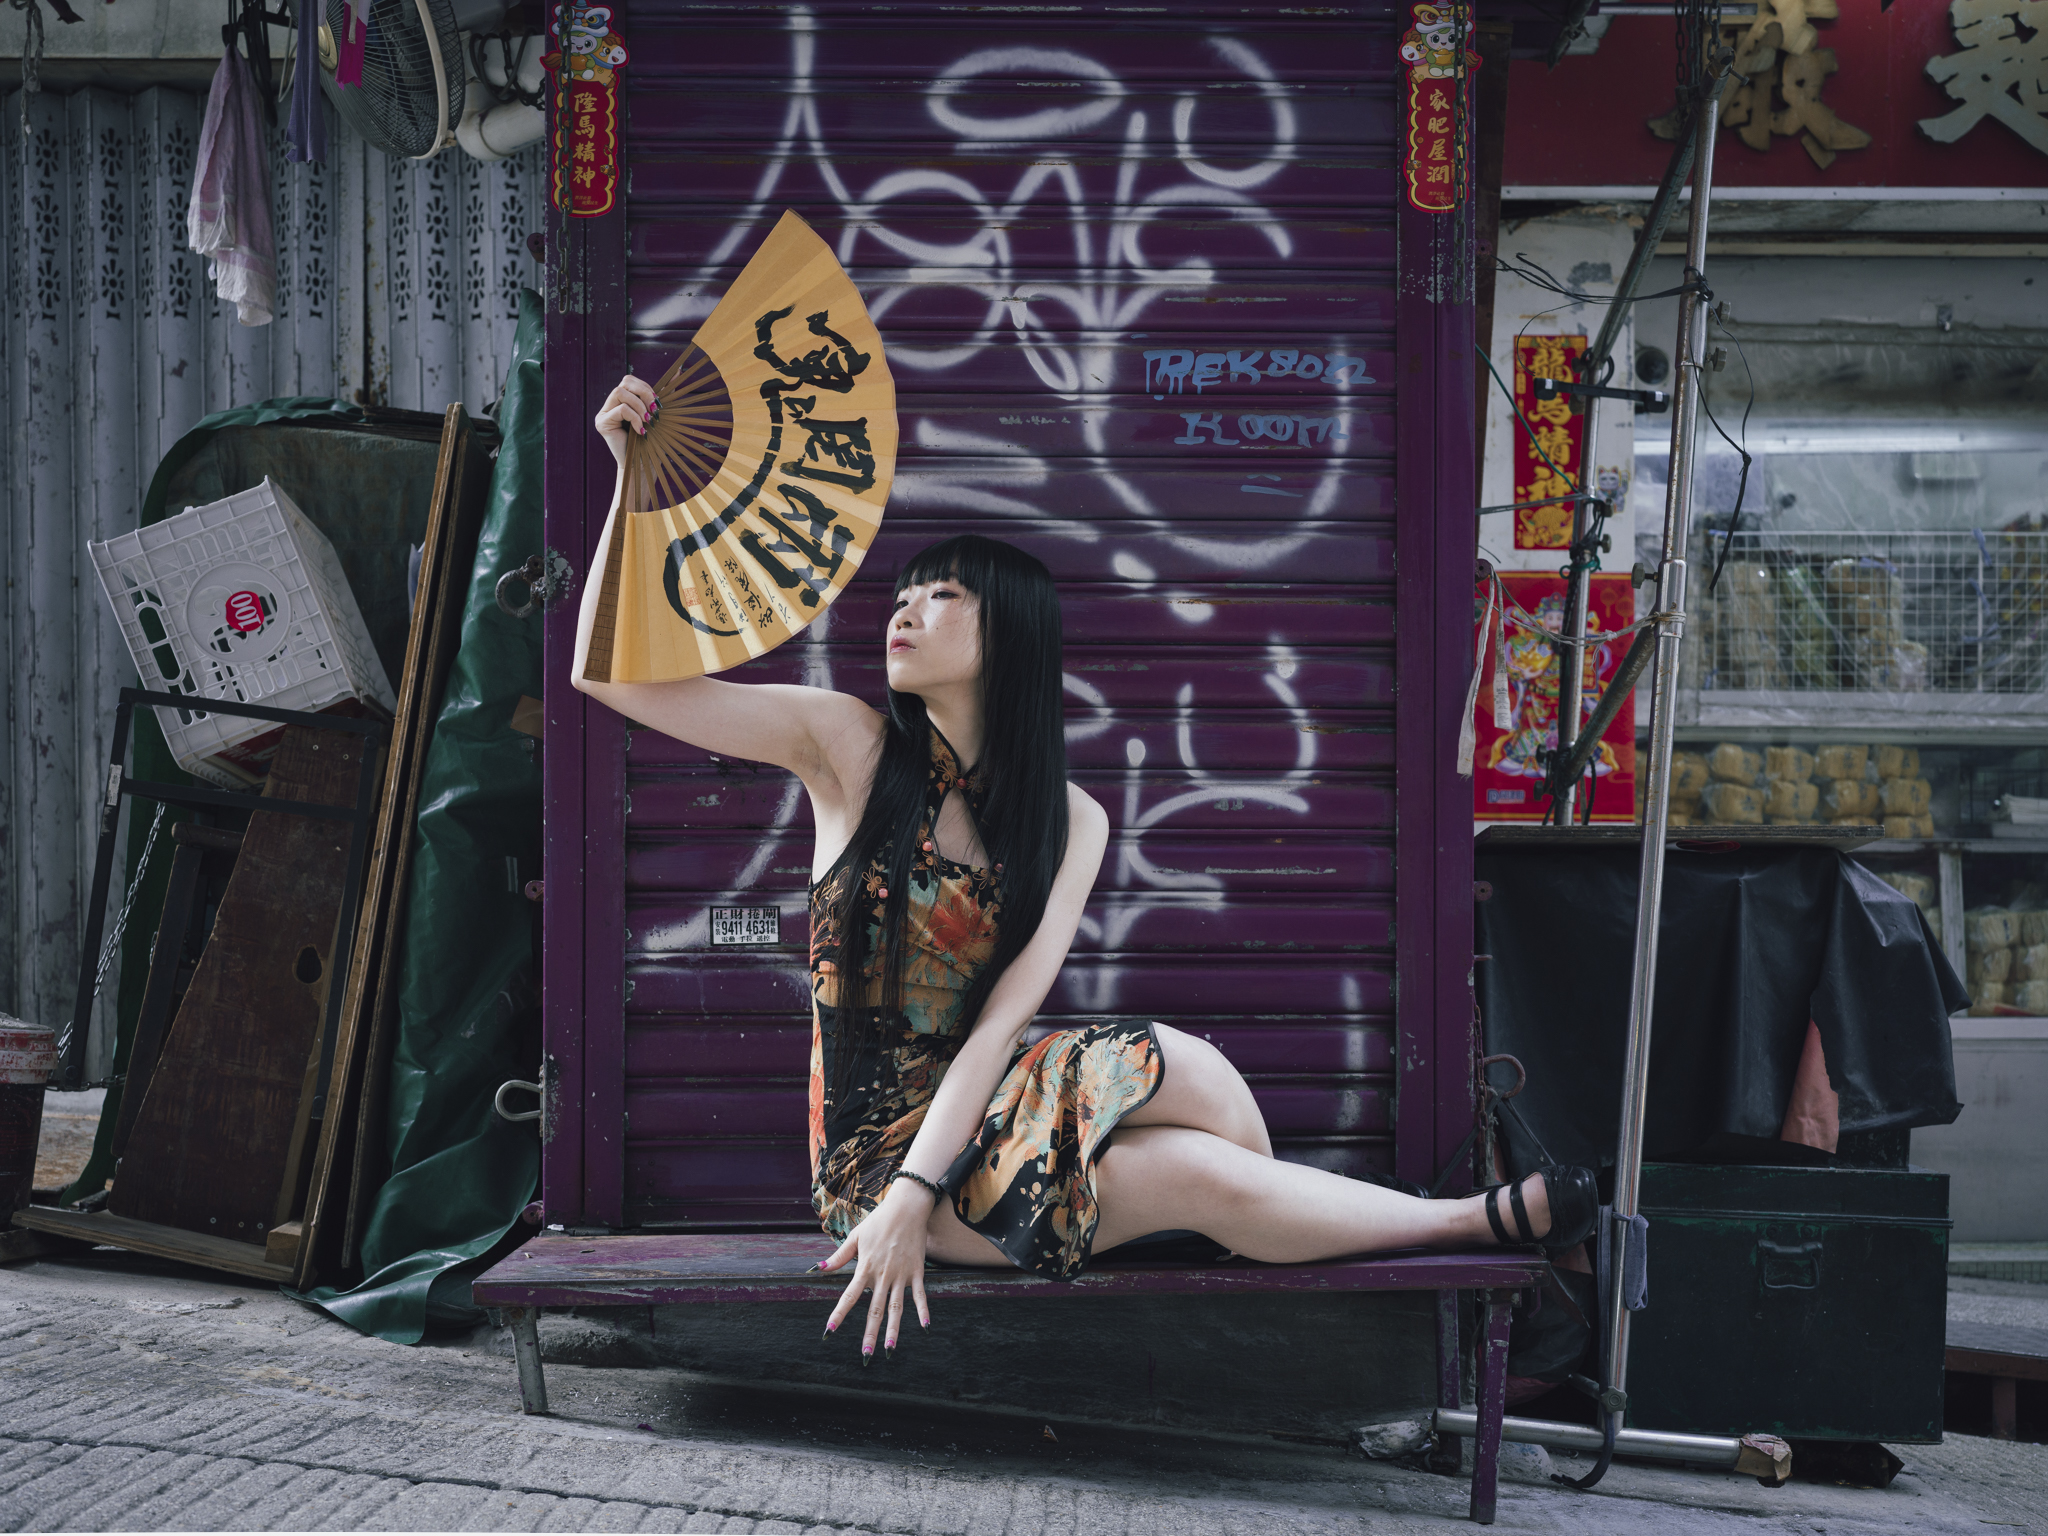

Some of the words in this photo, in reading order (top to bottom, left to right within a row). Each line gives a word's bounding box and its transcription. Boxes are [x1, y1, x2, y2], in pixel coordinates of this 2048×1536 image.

[573, 92, 598, 189] 隆馬精神
[1426, 88, 1450, 184] 家肥屋潤
[230, 593, 262, 629] 100
[722, 920, 742, 935] 9411
[746, 920, 770, 934] 4631
